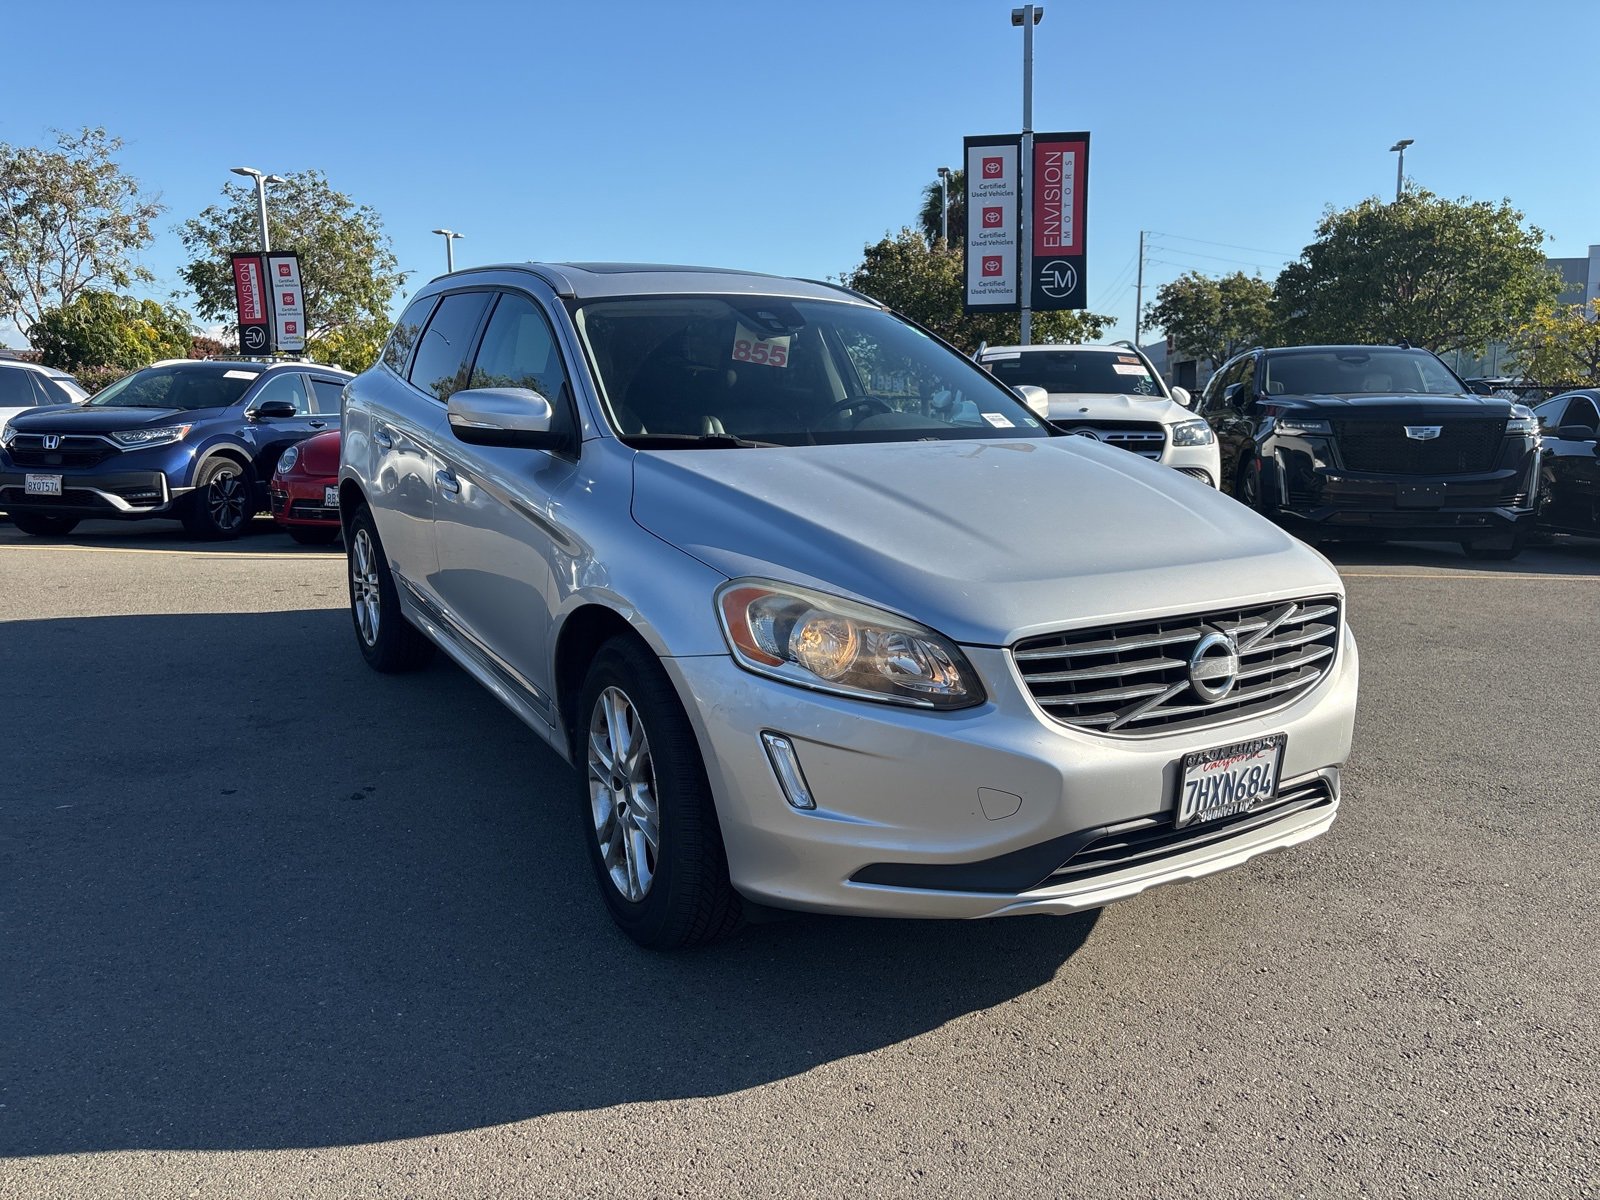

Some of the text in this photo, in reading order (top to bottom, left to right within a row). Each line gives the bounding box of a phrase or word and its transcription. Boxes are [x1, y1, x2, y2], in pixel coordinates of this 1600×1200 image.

[979, 182, 1007, 190] Certified
[1043, 151, 1062, 247] ENVISION
[1063, 160, 1073, 239] MOTORS
[238, 263, 255, 319] ENVISION
[978, 280, 1006, 288] Certified
[733, 339, 788, 367] 855
[1185, 762, 1272, 815] 7HXN684
